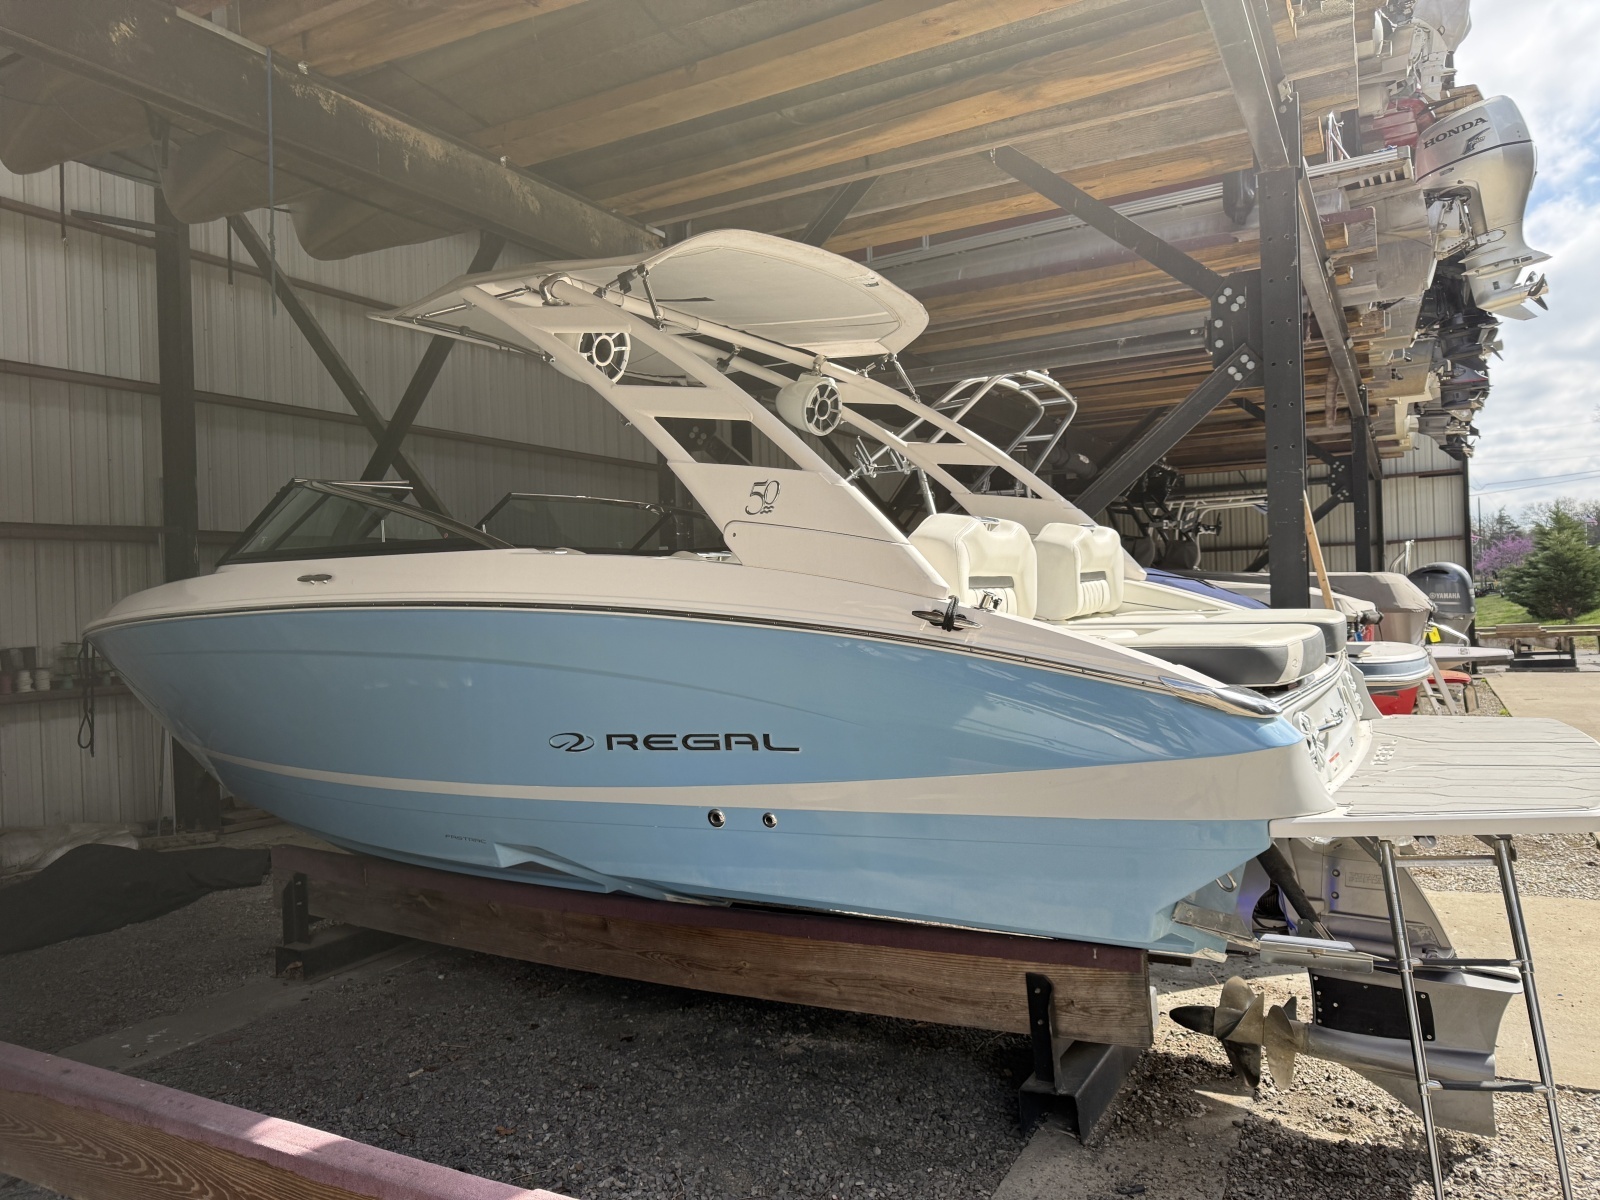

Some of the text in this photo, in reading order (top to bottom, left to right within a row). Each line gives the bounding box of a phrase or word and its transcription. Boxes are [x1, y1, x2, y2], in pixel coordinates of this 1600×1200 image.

[1423, 117, 1488, 150] HONDA
[745, 479, 780, 515] 50
[606, 733, 800, 751] REGAL
